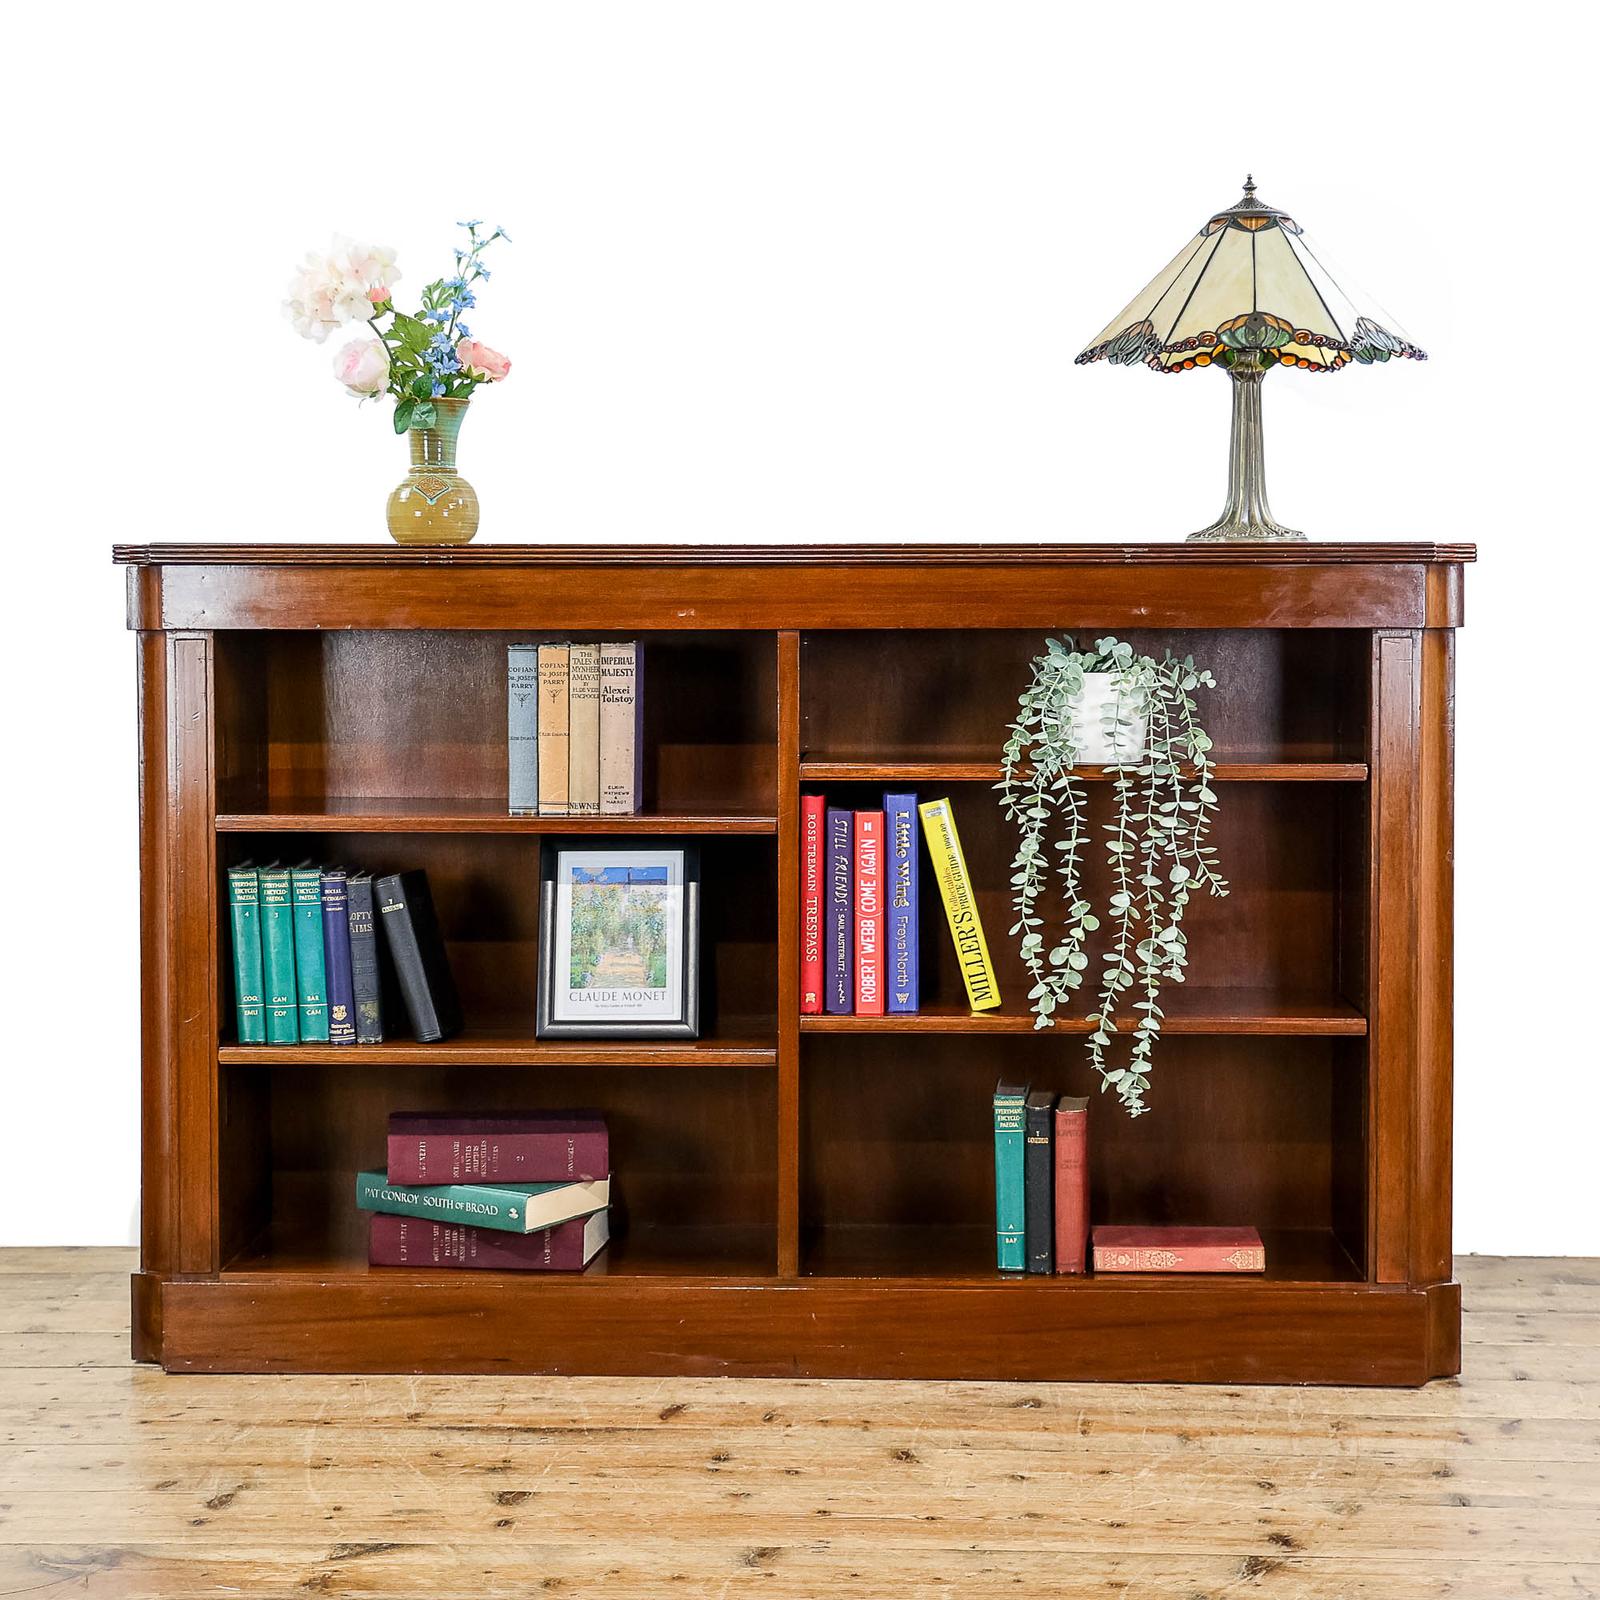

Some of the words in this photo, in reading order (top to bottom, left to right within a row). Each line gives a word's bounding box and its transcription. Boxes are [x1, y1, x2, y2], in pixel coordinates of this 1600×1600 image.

[601, 656, 634, 665] IMPERIAL
[601, 668, 634, 677] MAJESTY
[602, 686, 630, 695] Alexei
[602, 695, 634, 704] Tolstoy
[807, 814, 817, 841] ROSE
[834, 818, 848, 850] STILL
[895, 811, 911, 858] Little
[807, 845, 817, 892] TREMAIN
[834, 855, 849, 905] FRIENDS
[893, 860, 911, 908] Wing
[948, 854, 963, 882] GUIDE
[860, 880, 877, 912] COME
[956, 884, 970, 910] PRICE
[806, 897, 818, 962] TRESPASS
[838, 914, 846, 931] SAUL
[860, 920, 876, 954] WEBB
[896, 916, 909, 950] Freya
[838, 932, 846, 972] AUSTERLITZ
[953, 911, 993, 1003] MILLER'S
[861, 958, 877, 1003] ROBERT
[896, 952, 909, 987] North
[569, 991, 617, 1002] CLAUDE
[623, 990, 667, 1001] MONET
[365, 1187, 380, 1198] PAT
[381, 1190, 419, 1204] CONROY
[423, 1196, 453, 1209] SOUTH
[455, 1202, 465, 1210] OF
[466, 1202, 499, 1215] BROAD
